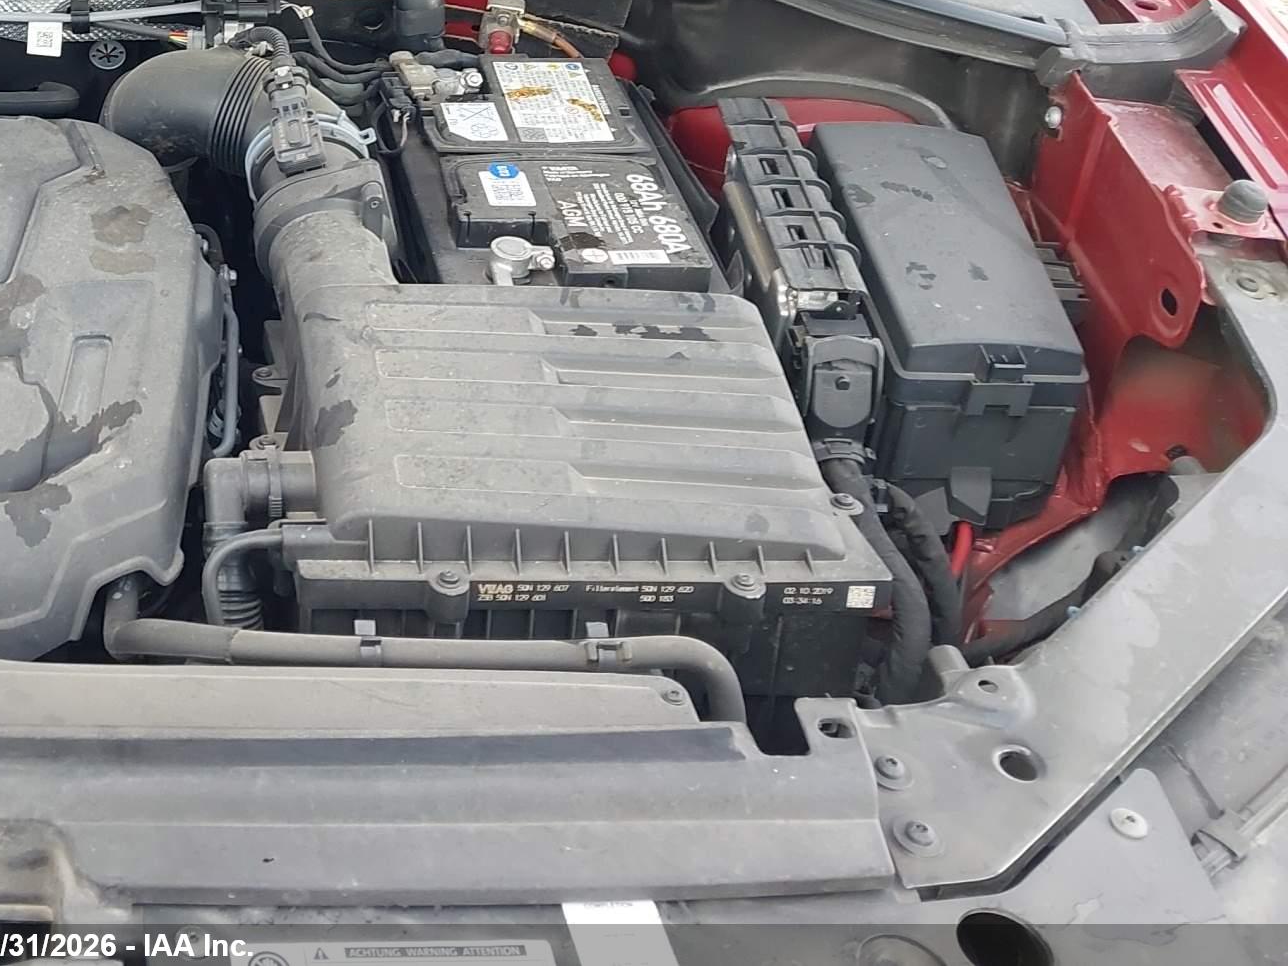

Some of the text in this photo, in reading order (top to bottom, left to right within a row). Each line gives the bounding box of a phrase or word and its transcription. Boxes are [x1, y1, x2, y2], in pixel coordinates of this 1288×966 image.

[557, 200, 588, 227] AGM
[626, 174, 692, 254] 68Ah 680A
[406, 946, 458, 956] WARNING
[462, 945, 520, 956] ATTENTION
